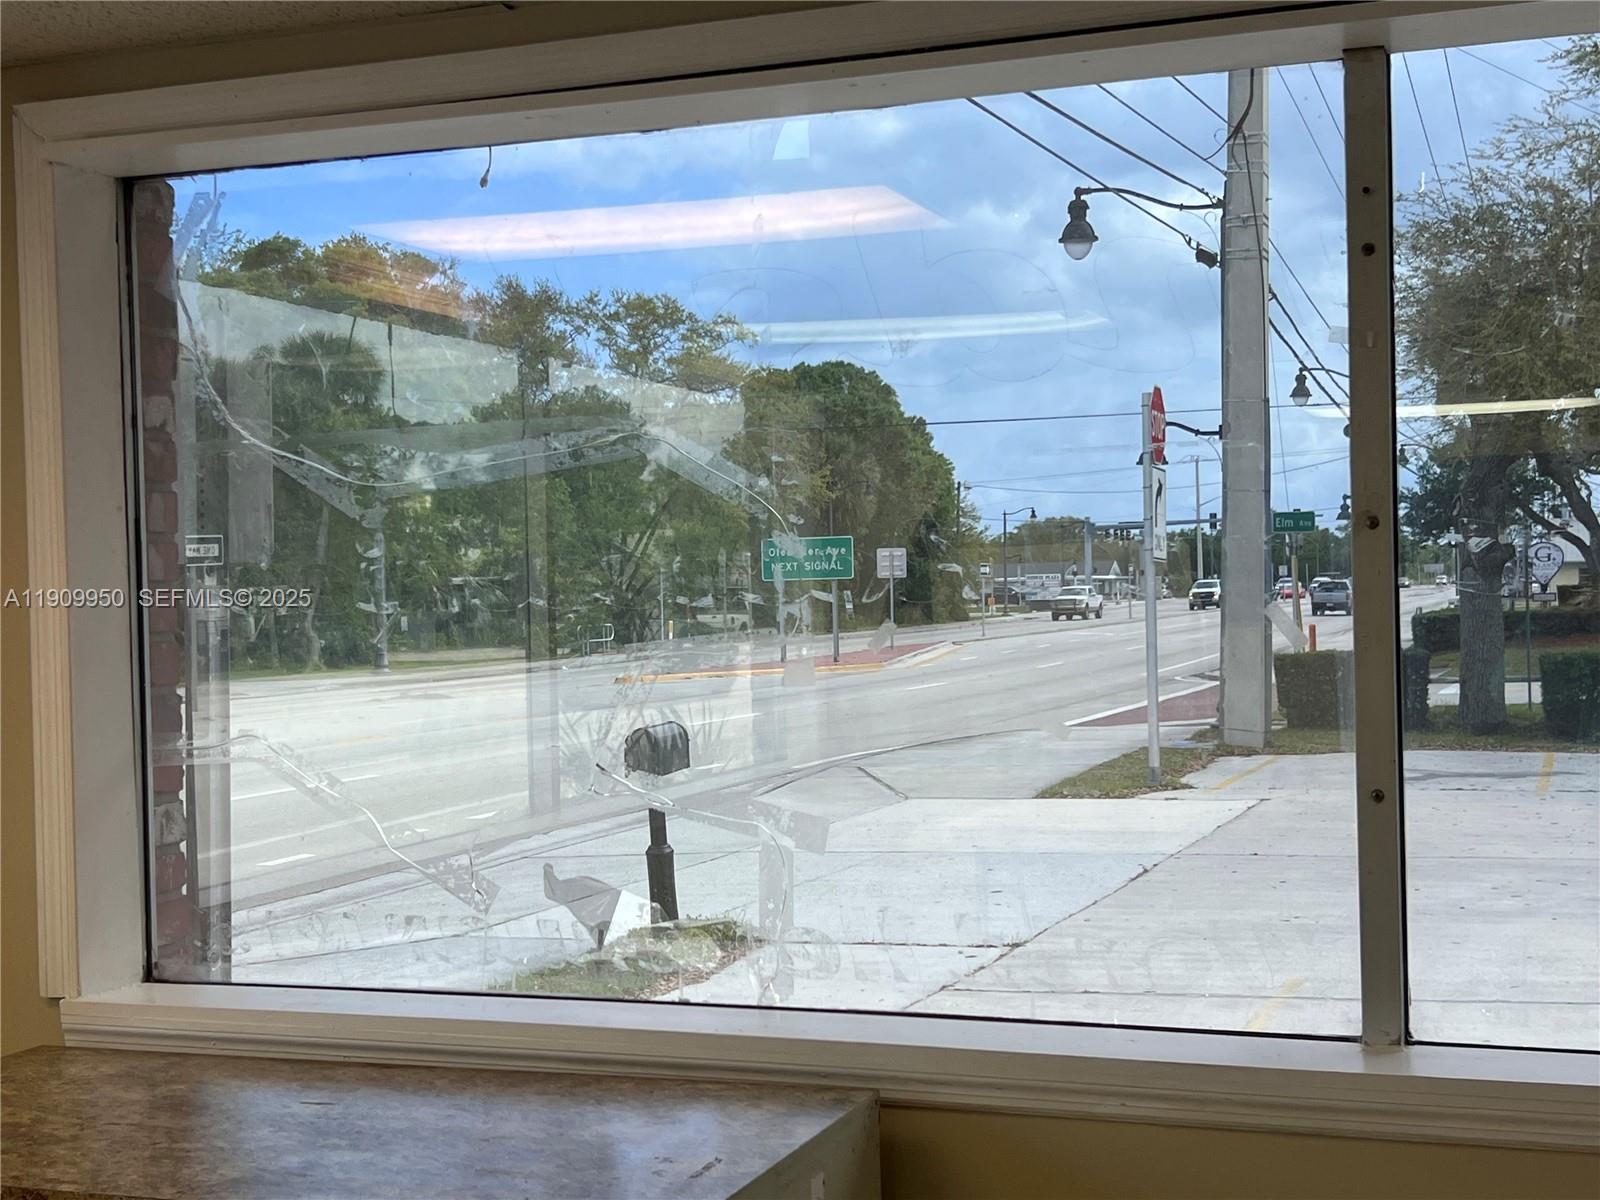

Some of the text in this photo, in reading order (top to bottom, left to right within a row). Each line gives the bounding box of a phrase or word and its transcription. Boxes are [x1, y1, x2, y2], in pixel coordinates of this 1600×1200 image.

[1151, 410, 1165, 440] STOP
[1275, 517, 1294, 528] Elm
[768, 546, 847, 558] Oleaer Ave
[771, 561, 844, 571] NEXT SIGNAL
